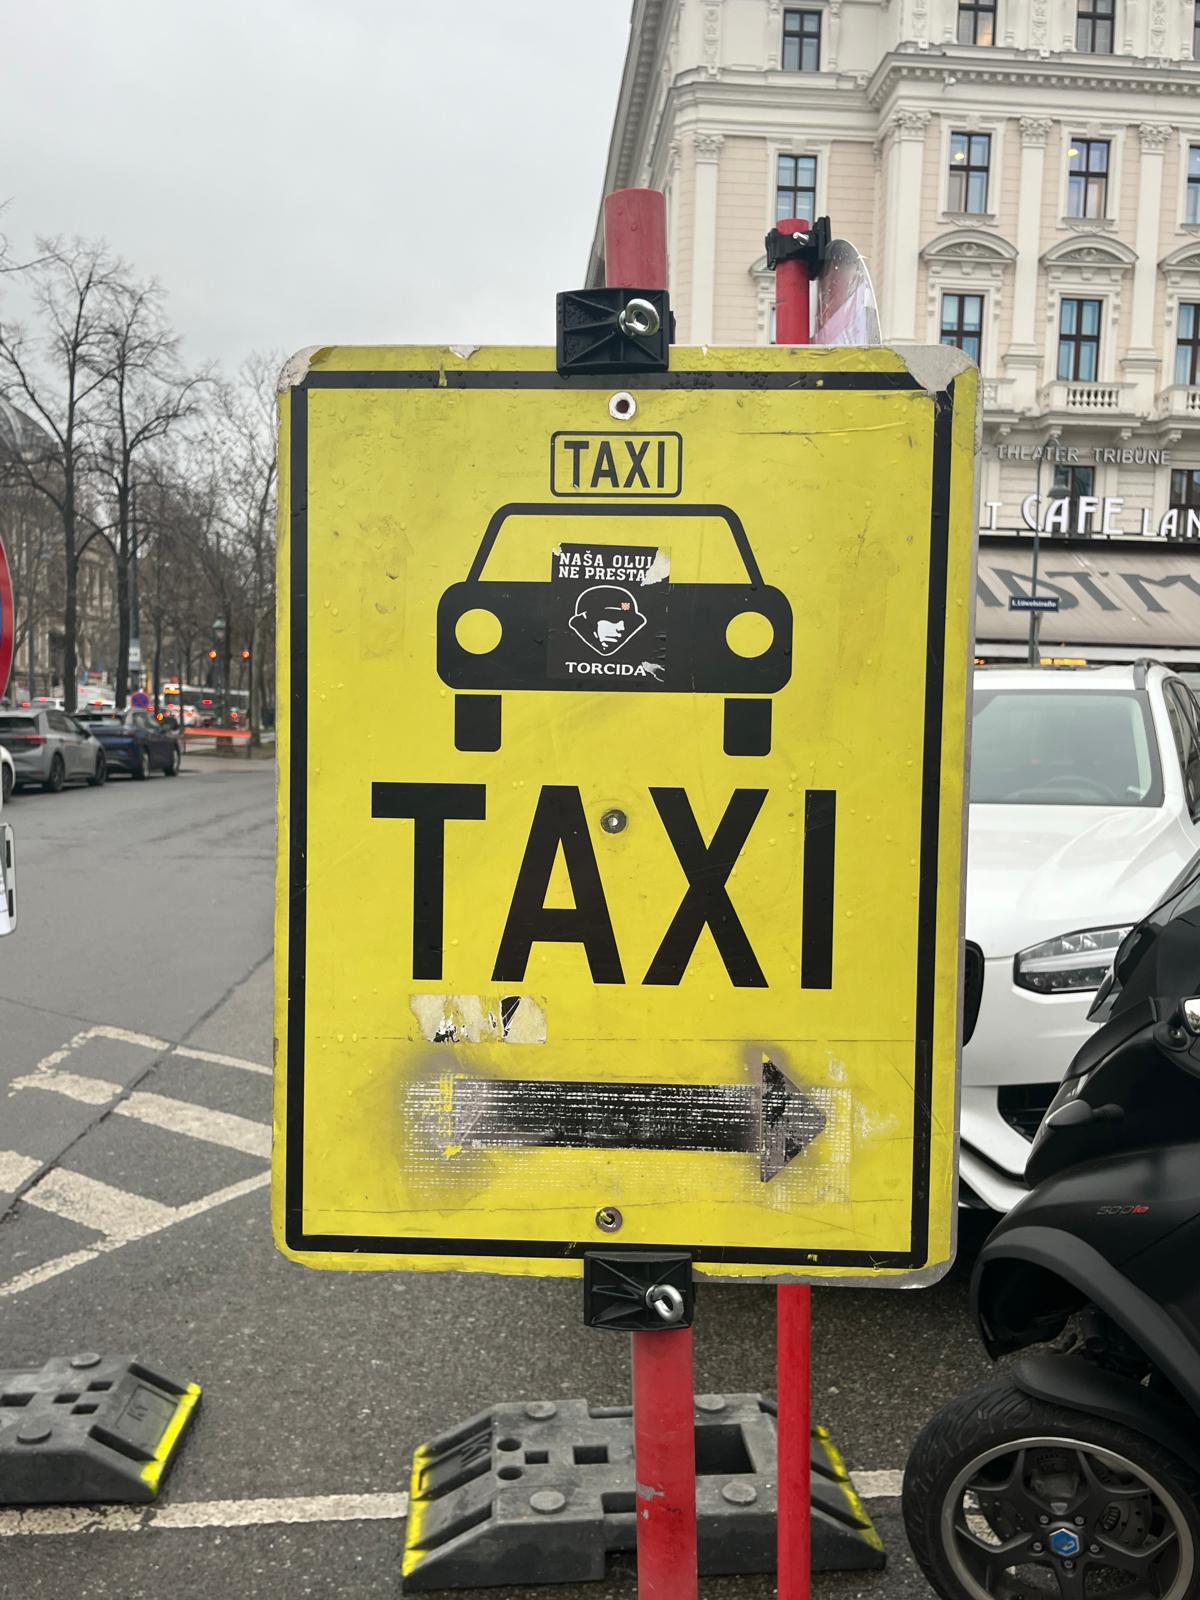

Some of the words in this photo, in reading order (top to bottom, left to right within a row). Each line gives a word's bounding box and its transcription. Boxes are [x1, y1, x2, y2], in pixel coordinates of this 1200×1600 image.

[564, 440, 665, 488] TAXI
[998, 444, 1080, 463] THEATER
[1093, 446, 1172, 465] TRIBÜNE
[559, 550, 604, 567] NAŠA
[558, 566, 580, 579] NE
[565, 661, 647, 677] TORCIDA
[371, 781, 837, 990] TAXI
